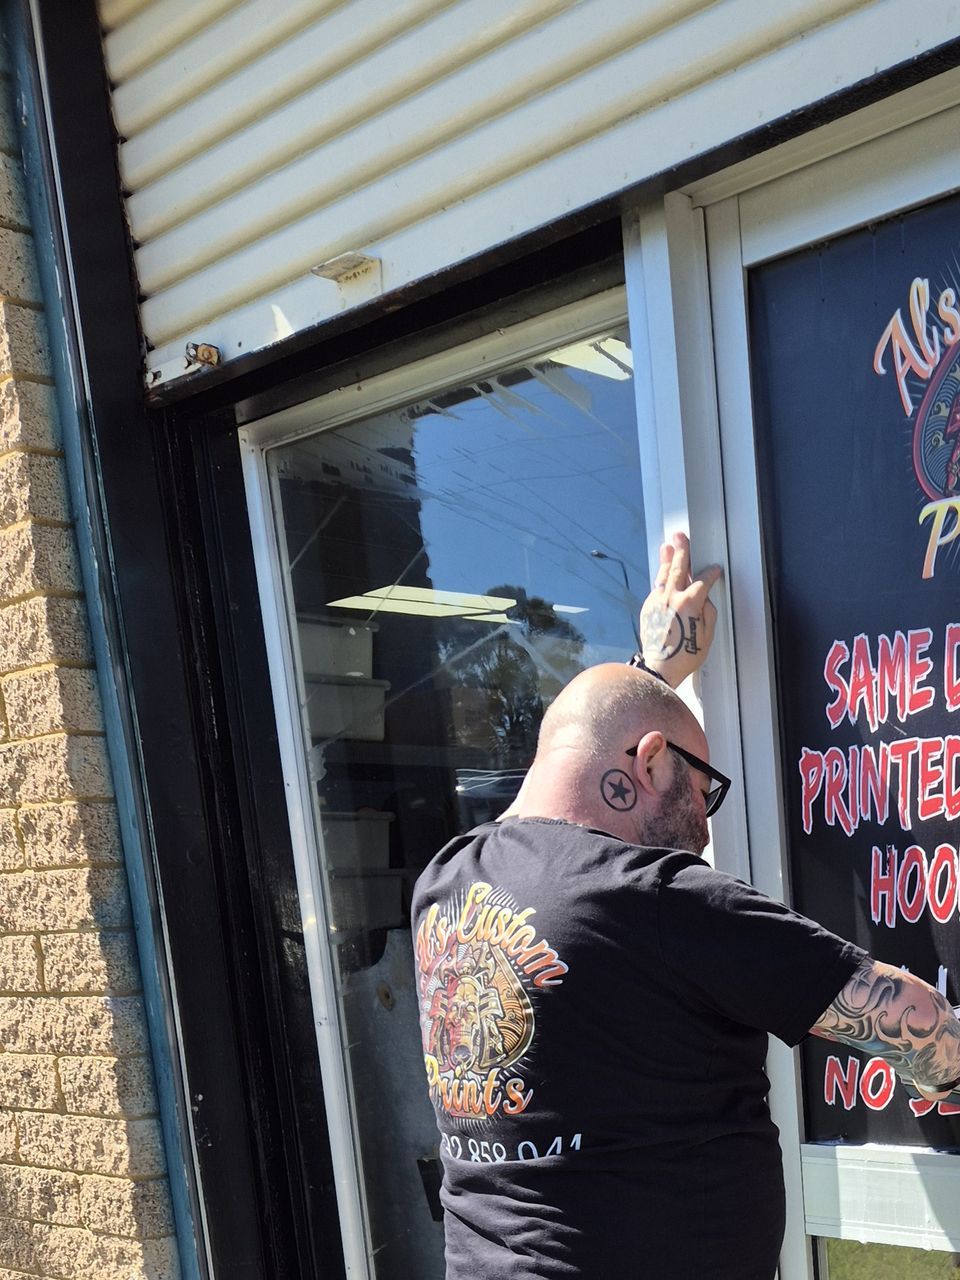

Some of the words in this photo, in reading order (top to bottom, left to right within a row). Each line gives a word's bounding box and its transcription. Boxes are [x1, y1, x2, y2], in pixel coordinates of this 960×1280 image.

[824, 628, 936, 733] SAME
[457, 881, 569, 988] Custom
[824, 1055, 896, 1111] NO
